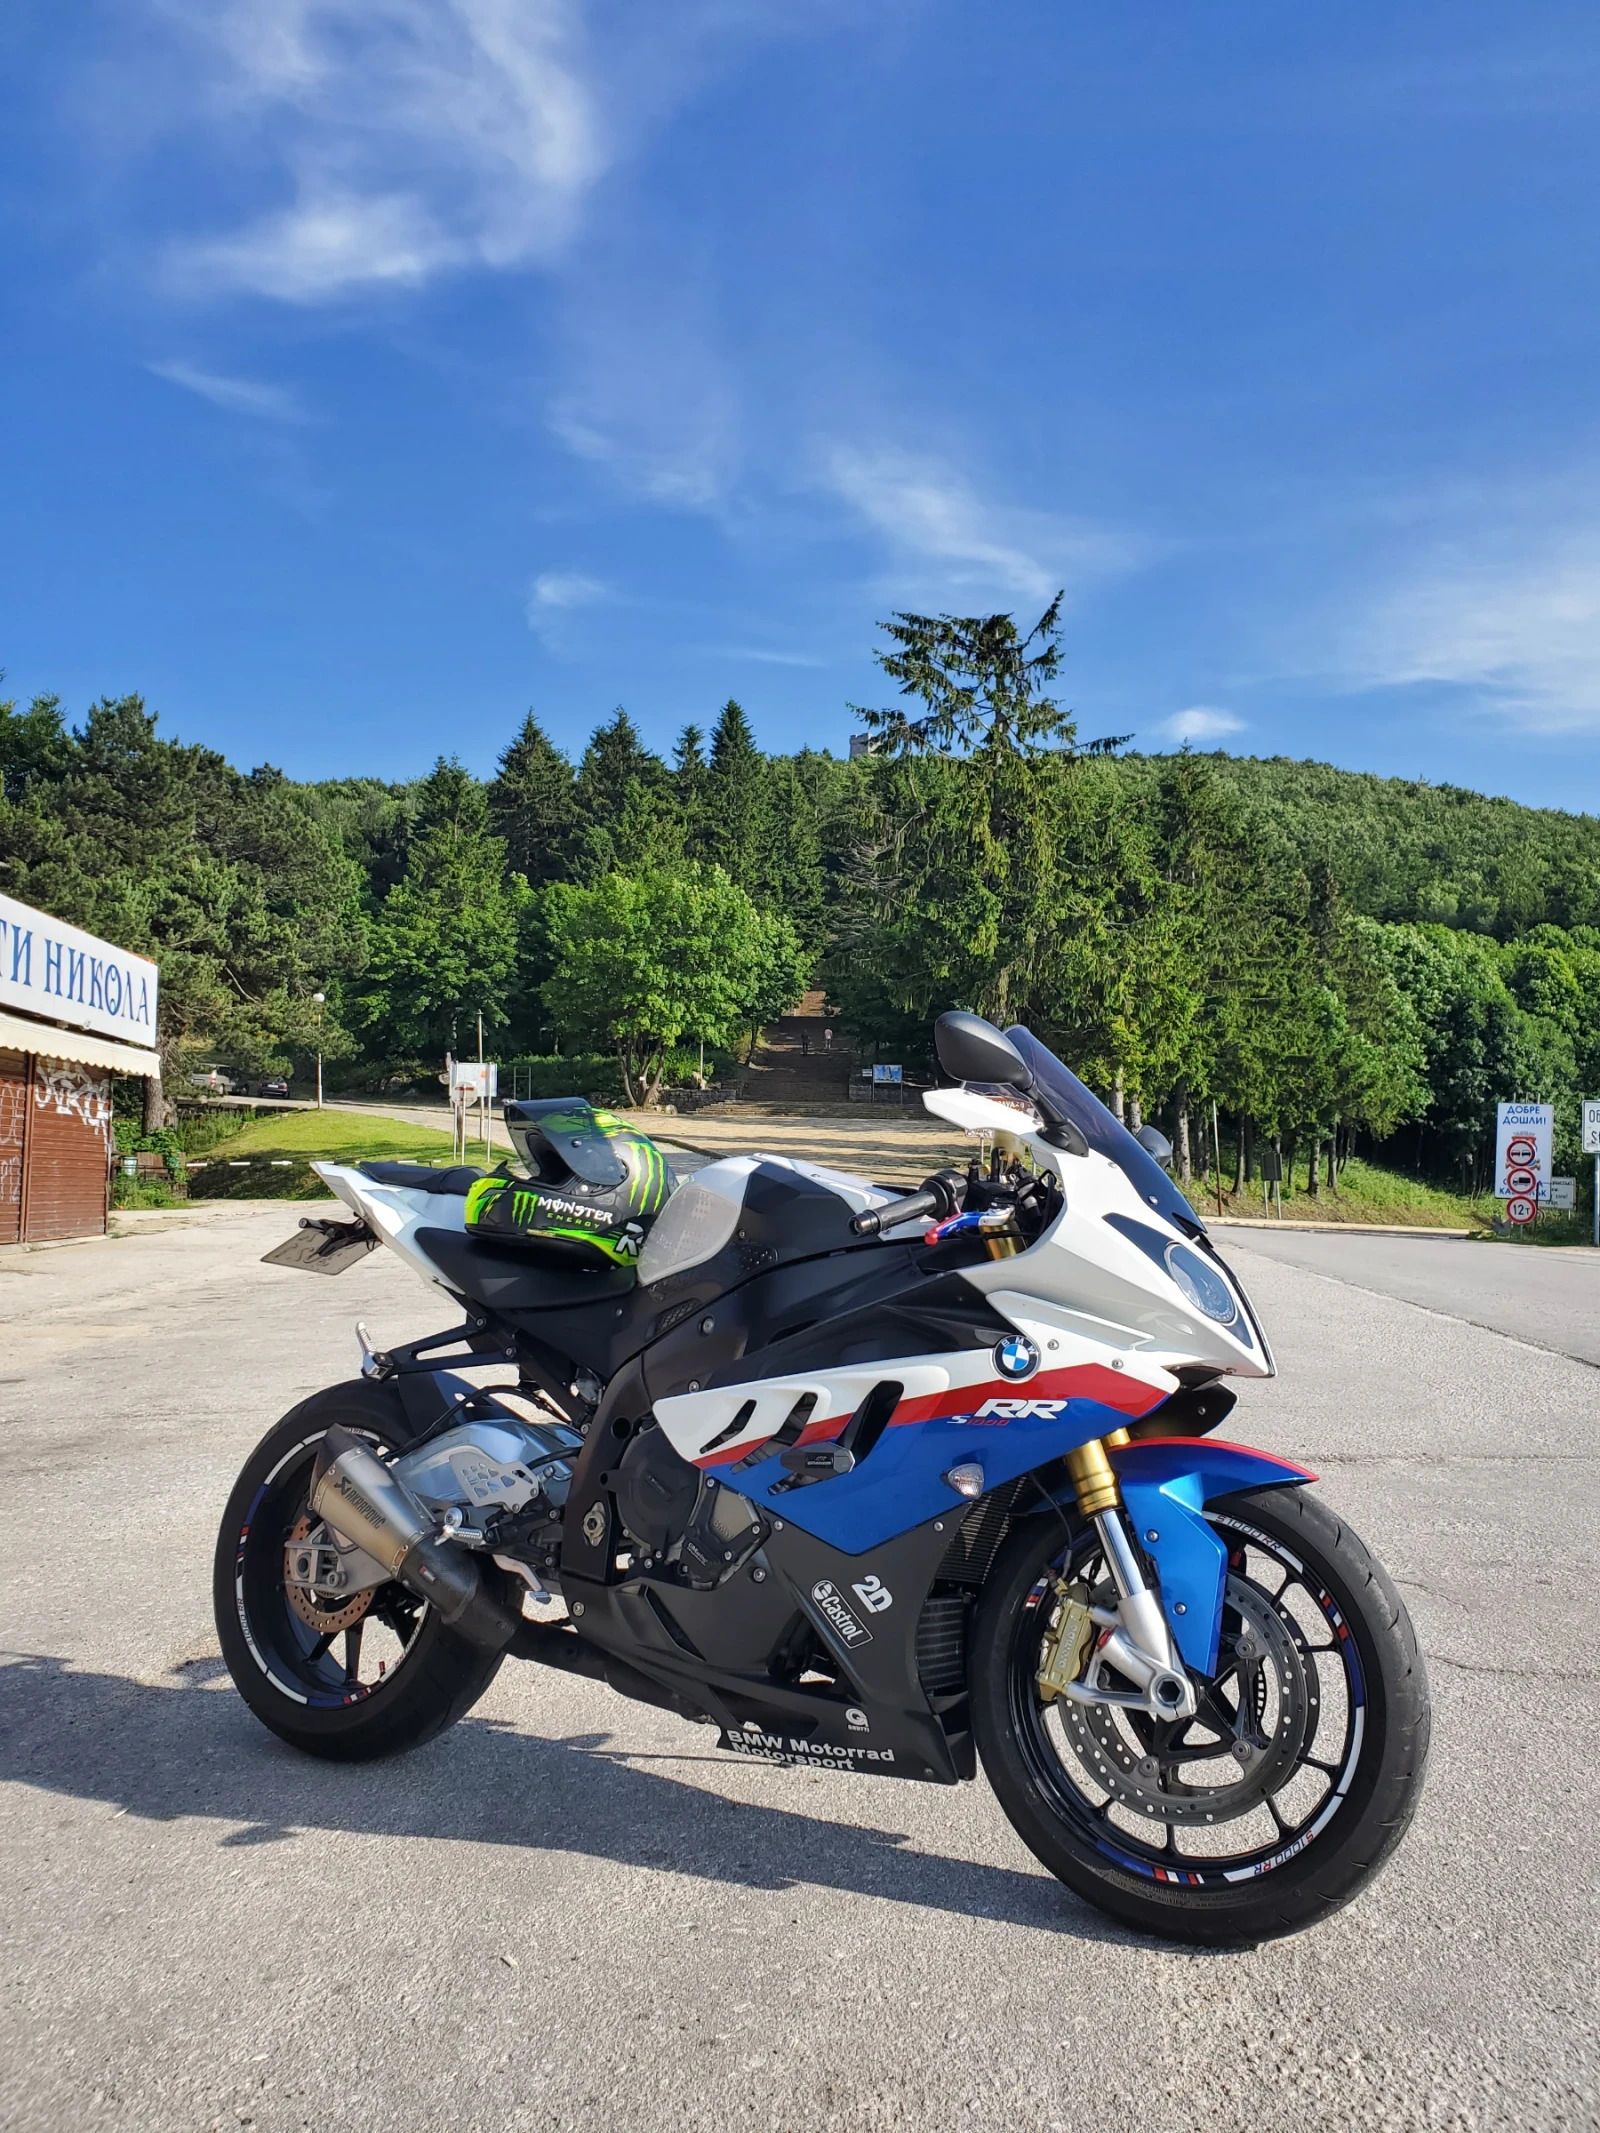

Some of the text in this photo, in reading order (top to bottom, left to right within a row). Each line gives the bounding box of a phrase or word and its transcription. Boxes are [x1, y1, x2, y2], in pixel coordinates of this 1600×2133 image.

[44, 938, 150, 1026] НИКОЛА
[1507, 1105, 1540, 1114] ДОБРЕ
[546, 1212, 601, 1229] ENERGY
[1001, 1336, 1039, 1356] BMW
[973, 1398, 1068, 1420] RR
[821, 1595, 864, 1641] Castrol
[726, 1729, 896, 1762] BMW Motorrad
[731, 1742, 855, 1770] Motorsport
